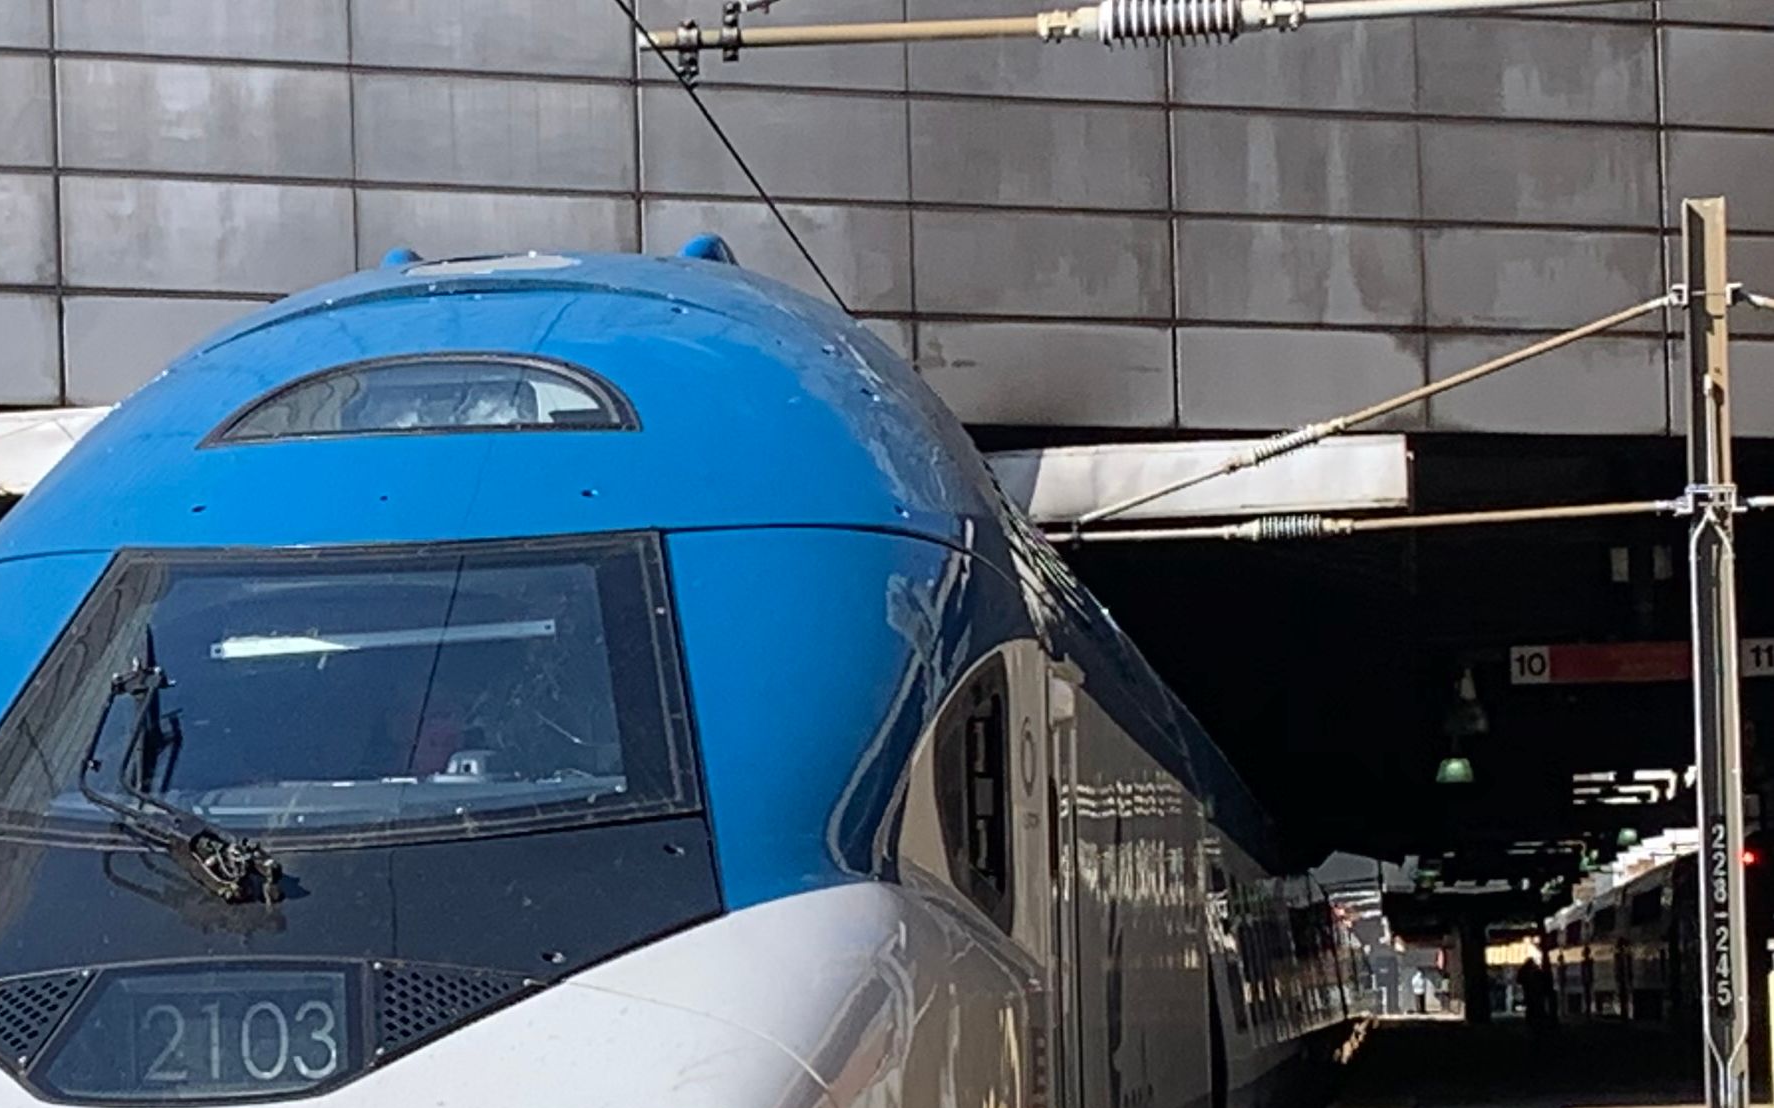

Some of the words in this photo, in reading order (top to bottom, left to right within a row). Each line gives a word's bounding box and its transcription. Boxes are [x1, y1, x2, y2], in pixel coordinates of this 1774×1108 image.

[1515, 653, 1546, 677] 10
[1749, 644, 1774, 667] 11
[145, 1001, 337, 1081] 2103
